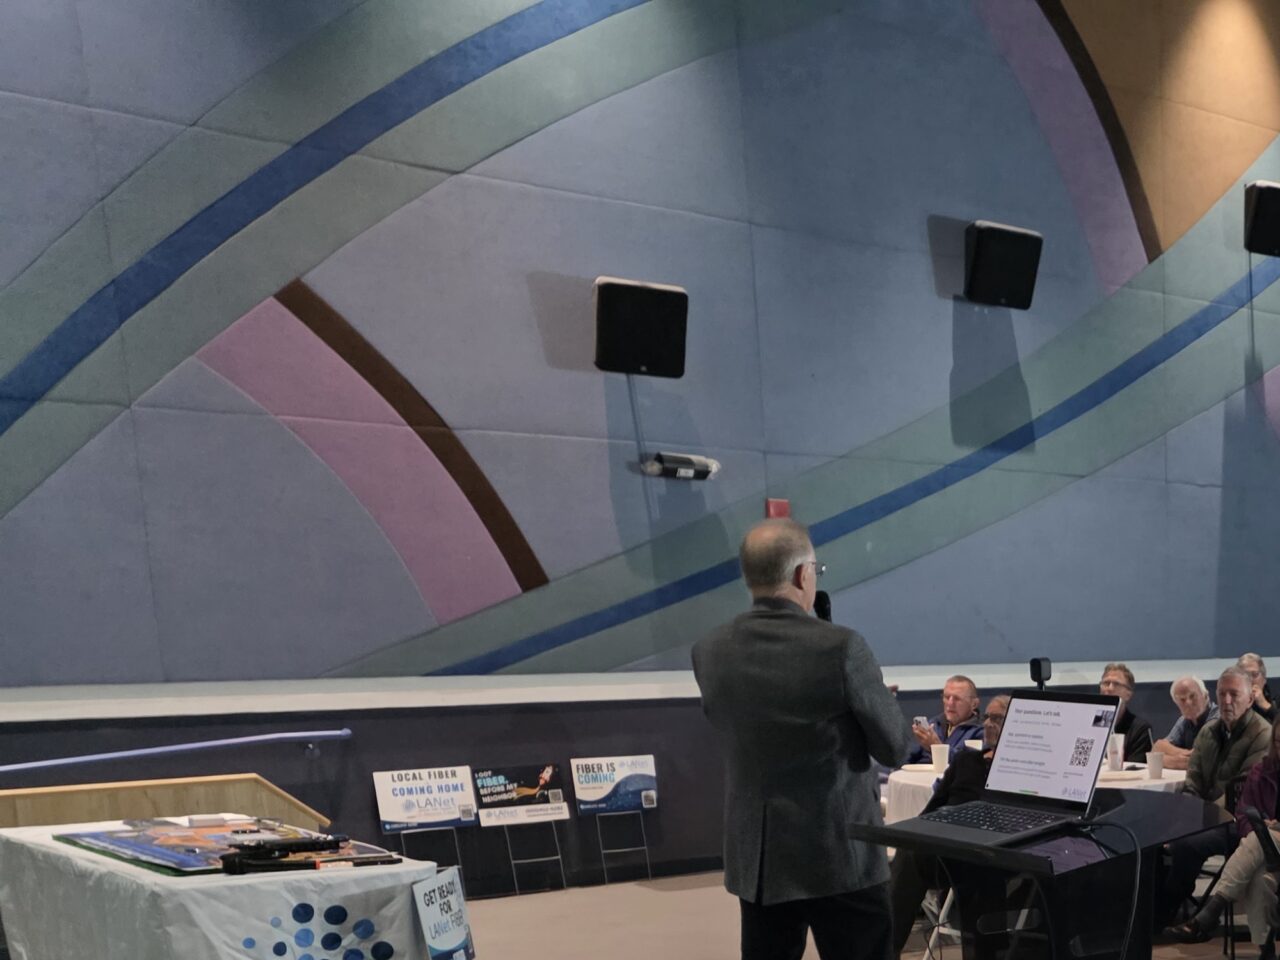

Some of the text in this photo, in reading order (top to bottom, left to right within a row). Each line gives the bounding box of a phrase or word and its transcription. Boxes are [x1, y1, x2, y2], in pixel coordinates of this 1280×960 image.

[576, 762, 616, 775] FIBER IS
[391, 769, 458, 783] LOCAL FIBER
[577, 772, 616, 785] COMING
[391, 782, 466, 797] COMING HOME
[479, 782, 518, 796] BEFORE MY
[416, 797, 456, 809] LANet
[423, 887, 438, 908] GET
[438, 899, 453, 917] FOR
